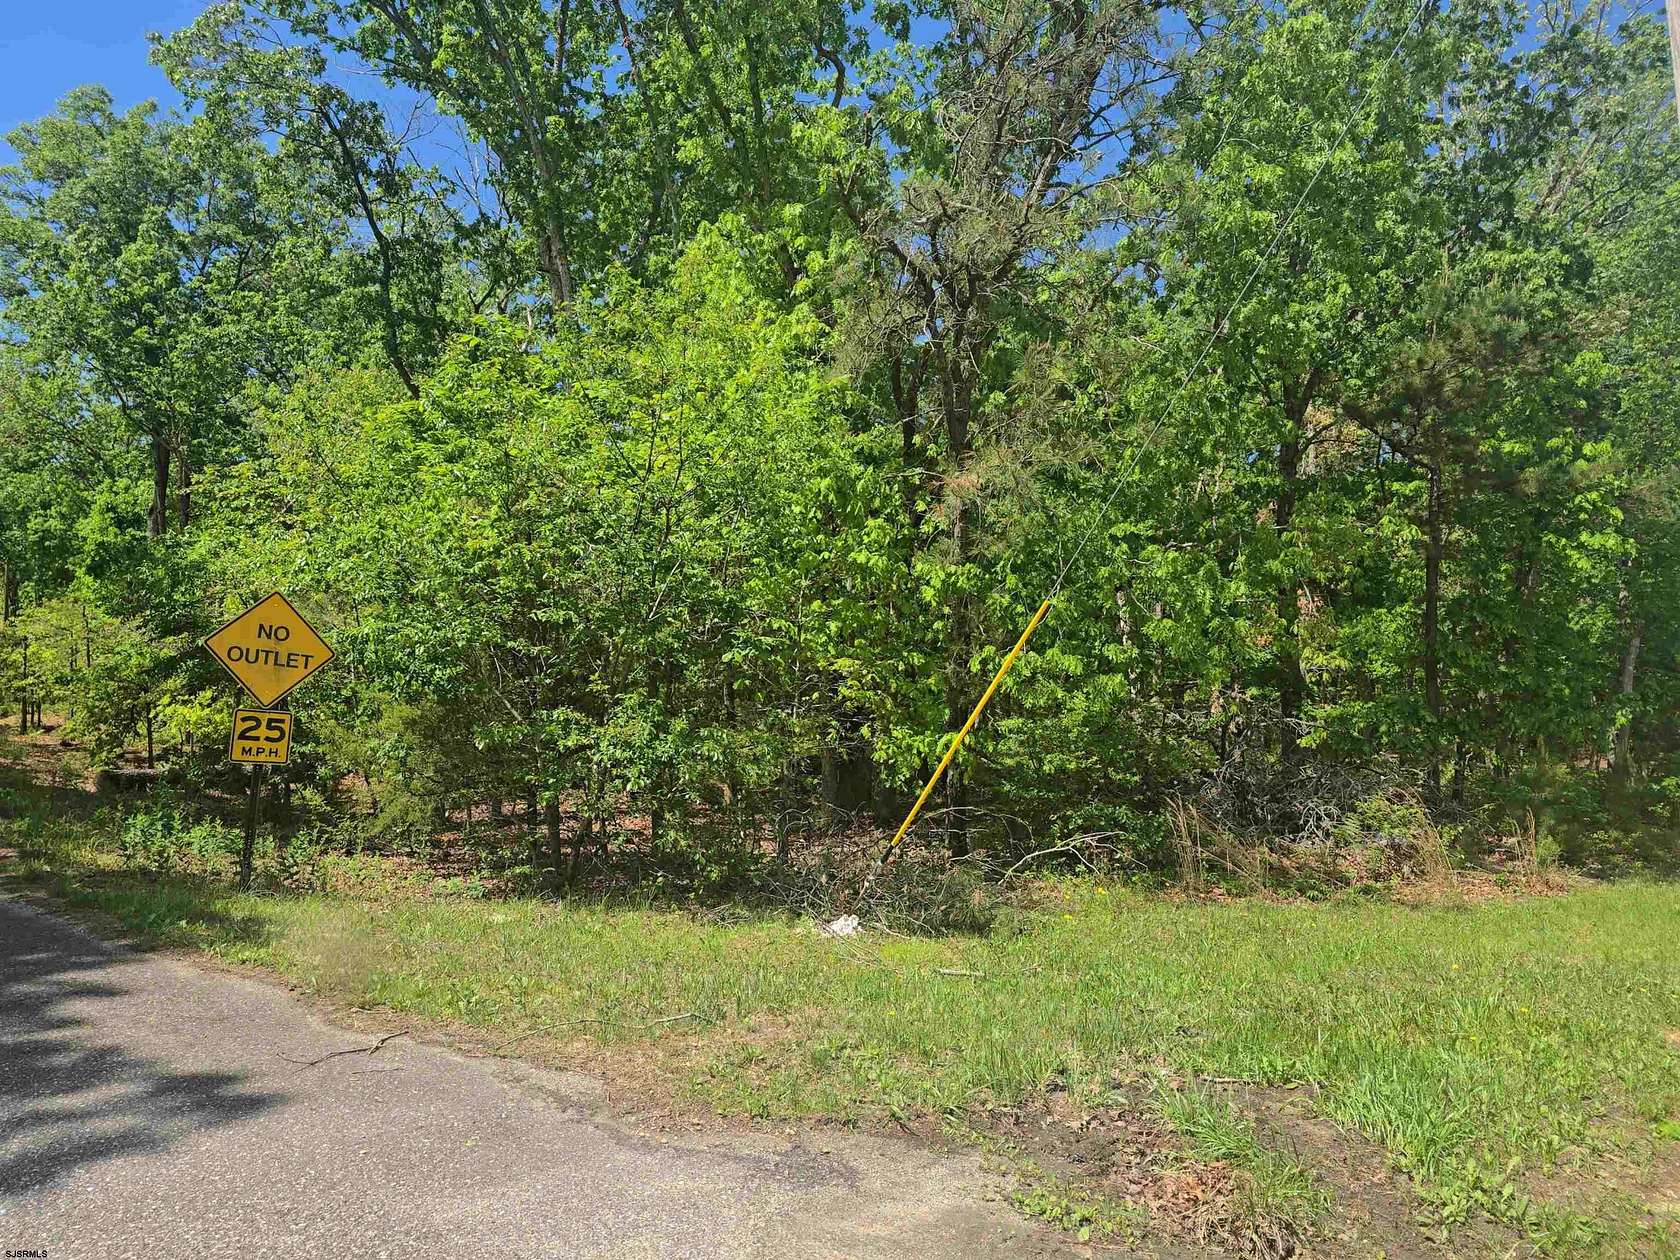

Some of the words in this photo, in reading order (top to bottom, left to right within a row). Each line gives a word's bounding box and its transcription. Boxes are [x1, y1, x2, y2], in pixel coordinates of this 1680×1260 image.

[257, 623, 290, 642] NO
[227, 645, 314, 670] OUTLET
[237, 715, 286, 743] 25
[241, 746, 281, 758] M.P.H.
